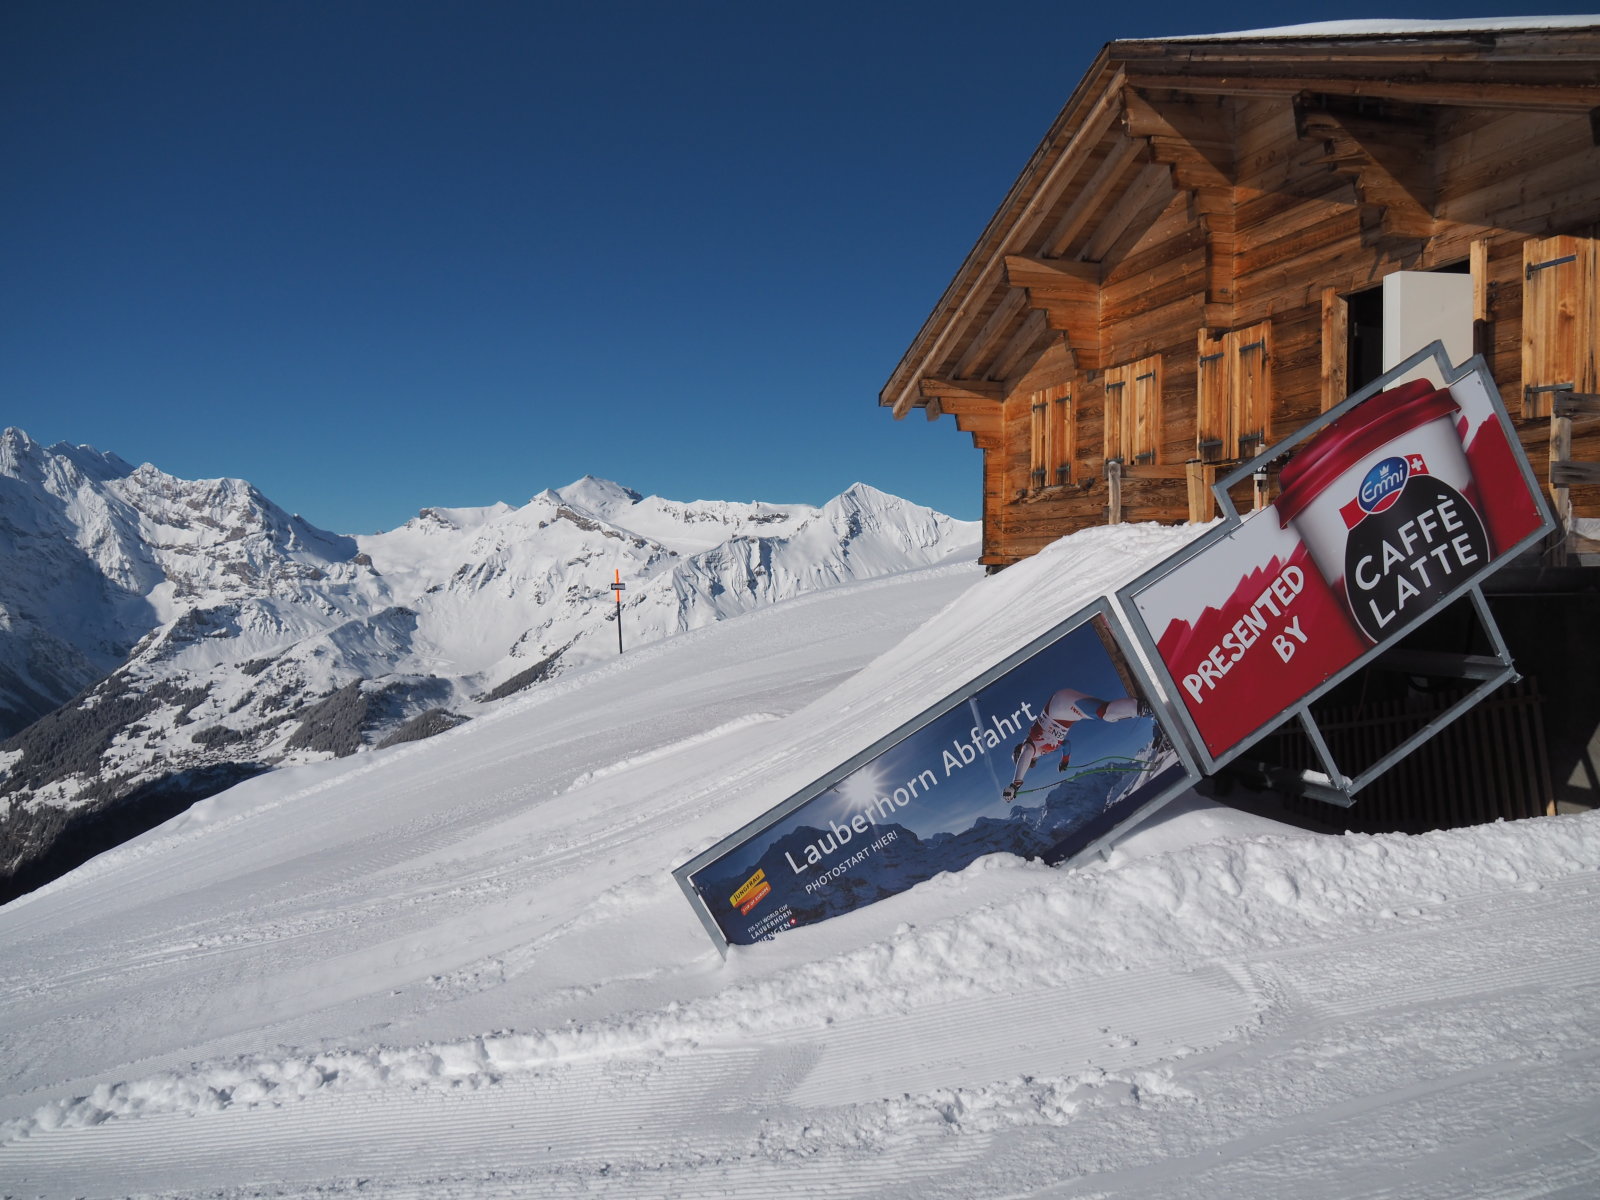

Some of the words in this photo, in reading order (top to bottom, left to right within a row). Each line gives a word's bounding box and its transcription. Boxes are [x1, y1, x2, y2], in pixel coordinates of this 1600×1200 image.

[1361, 464, 1404, 502] Emmi
[1355, 494, 1464, 590] CAFFÈ
[1369, 533, 1478, 629] LATTE
[1182, 565, 1305, 703] PRESENTED
[1271, 616, 1309, 663] BY
[785, 770, 938, 874] Lauberhorn
[943, 702, 1037, 776] Abfahrt
[733, 874, 760, 902] JUNGFRAU
[805, 847, 870, 894] PHOTOSTART
[871, 830, 898, 852] HIER!
[747, 925, 756, 933] FIS
[762, 910, 779, 924] WORLD
[779, 904, 788, 914] CUP
[751, 909, 793, 939] LAUBERHORN
